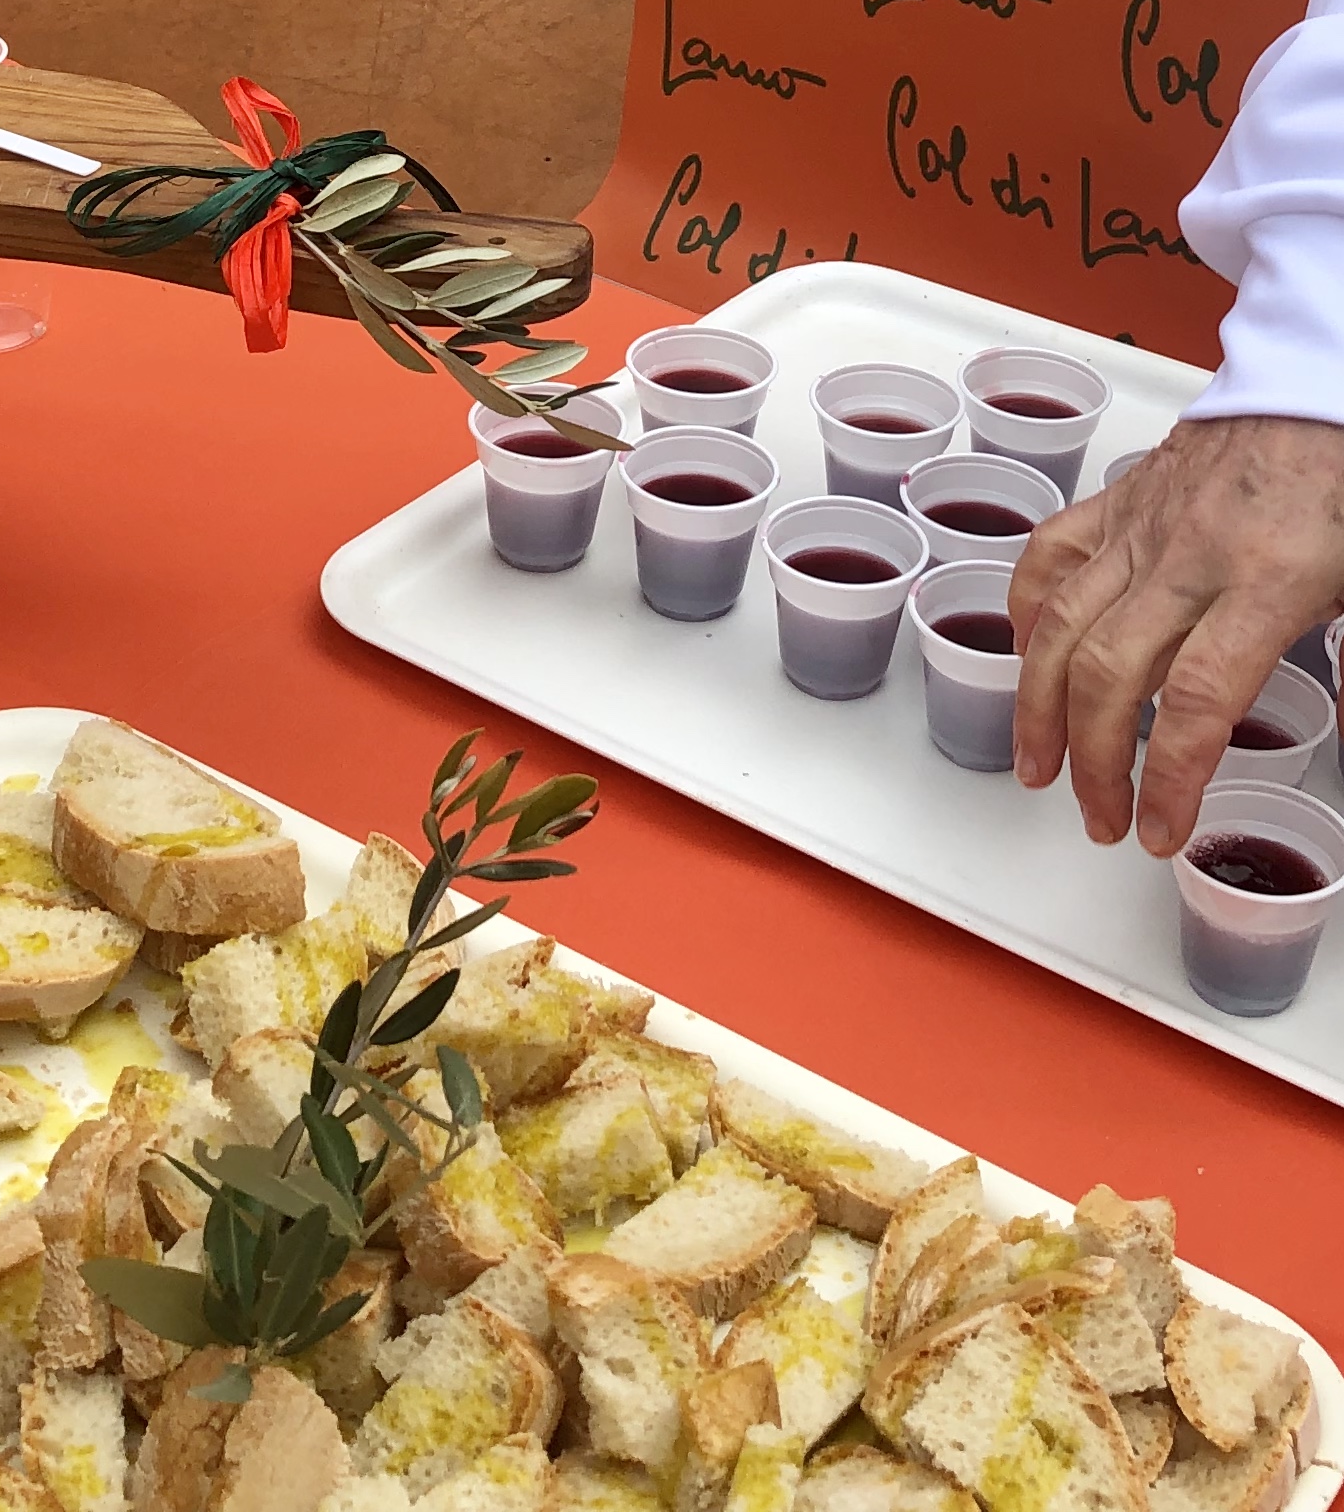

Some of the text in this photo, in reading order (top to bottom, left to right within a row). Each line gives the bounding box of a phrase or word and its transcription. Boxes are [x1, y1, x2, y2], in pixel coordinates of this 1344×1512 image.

[643, 153, 743, 274] Col
[886, 75, 973, 206] Col
[991, 152, 1054, 230] di
